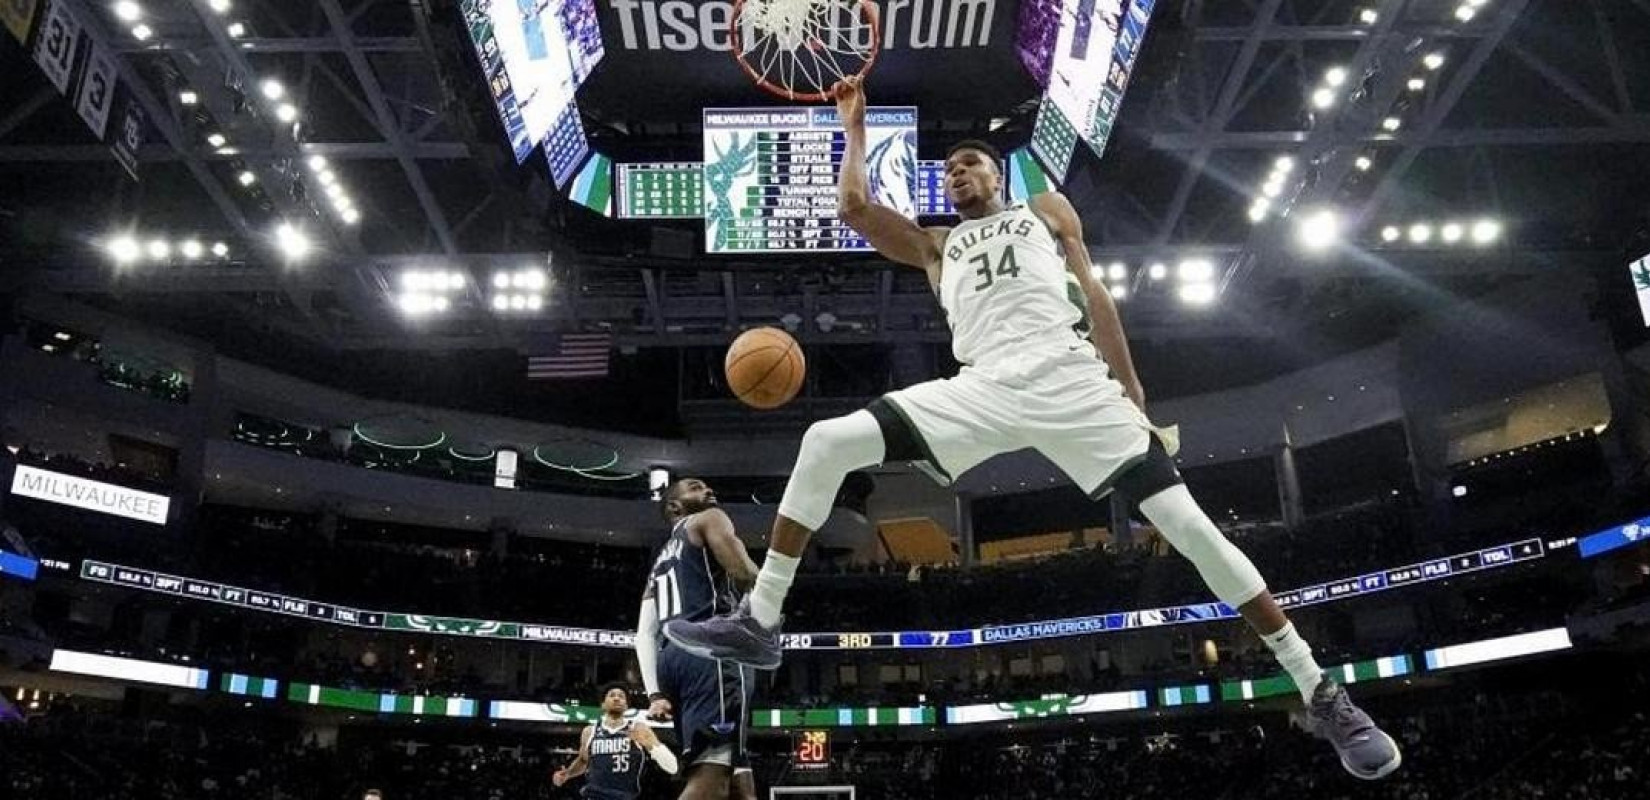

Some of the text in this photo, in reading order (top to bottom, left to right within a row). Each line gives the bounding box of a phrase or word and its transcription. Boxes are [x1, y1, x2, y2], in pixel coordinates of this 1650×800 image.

[706, 114, 807, 124] MILWAUKEE BUCKS
[813, 113, 914, 123] DALL AVERICKS
[780, 186, 838, 196] TURNOVER
[811, 197, 838, 206] FOUL
[947, 219, 1035, 262] BUCKS
[968, 244, 1021, 292] 34
[21, 473, 161, 518] MILWAUKEE
[1365, 577, 1380, 588] FT
[1484, 550, 1510, 563] TOL
[90, 565, 108, 577] FG
[225, 590, 241, 601] FT
[336, 610, 355, 621] TOL
[522, 624, 597, 642] MILWAUKEE
[984, 617, 1102, 641] DALLAS MAVERICKS
[839, 633, 872, 648] 3RD
[930, 633, 949, 647] 77
[590, 737, 631, 755] MAVS
[800, 742, 823, 761] 20
[611, 754, 631, 773] 35
